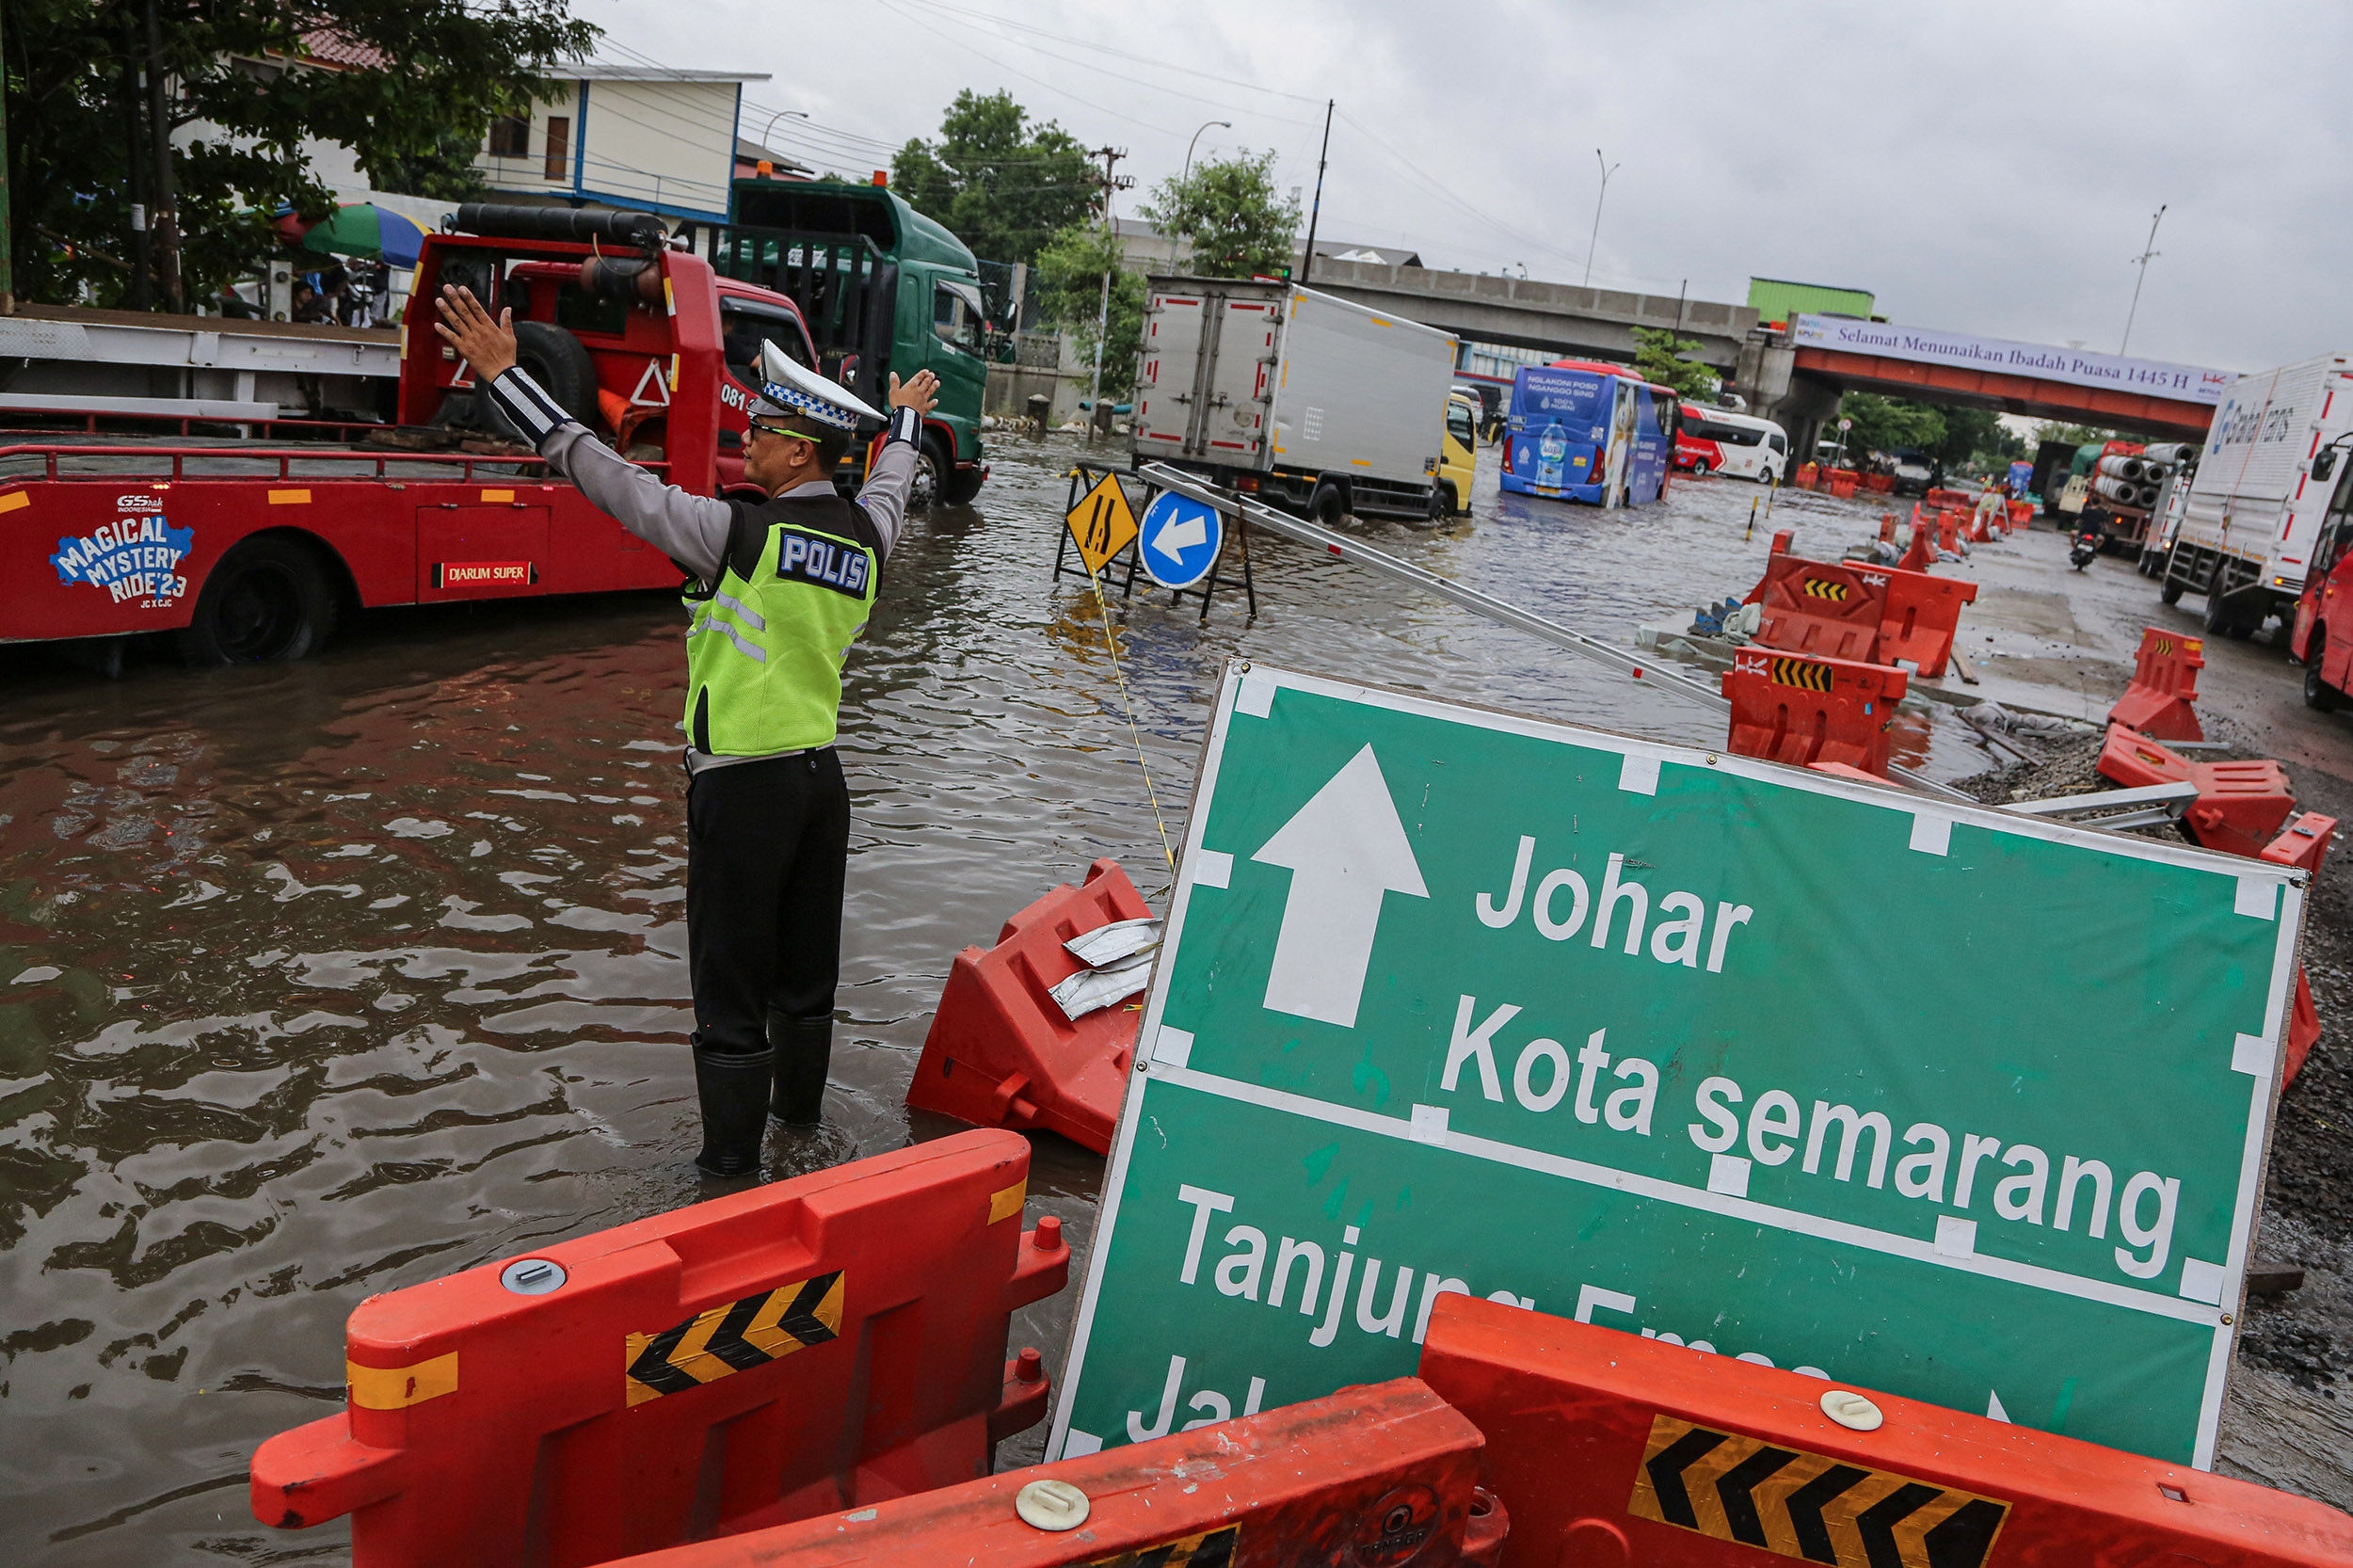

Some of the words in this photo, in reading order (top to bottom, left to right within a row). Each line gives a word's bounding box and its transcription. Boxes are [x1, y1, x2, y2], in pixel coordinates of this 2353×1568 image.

[1838, 328, 1897, 347] Selamat
[1903, 336, 2003, 362] Menunaikan
[2009, 349, 2065, 372] Ibadah
[2072, 359, 2121, 379] Puasa
[2128, 368, 2167, 385] 1445
[2172, 374, 2189, 390] H
[57, 517, 168, 579] MAGICAL
[86, 547, 183, 588] MYSTERY
[449, 568, 490, 582] DJARUM
[493, 567, 524, 580] SUPER
[781, 534, 871, 592] POLISI
[108, 572, 187, 604] RIDE'23
[1475, 834, 1754, 974] Johar
[1440, 993, 1659, 1137] Kota
[1688, 1076, 2181, 1280] semarang
